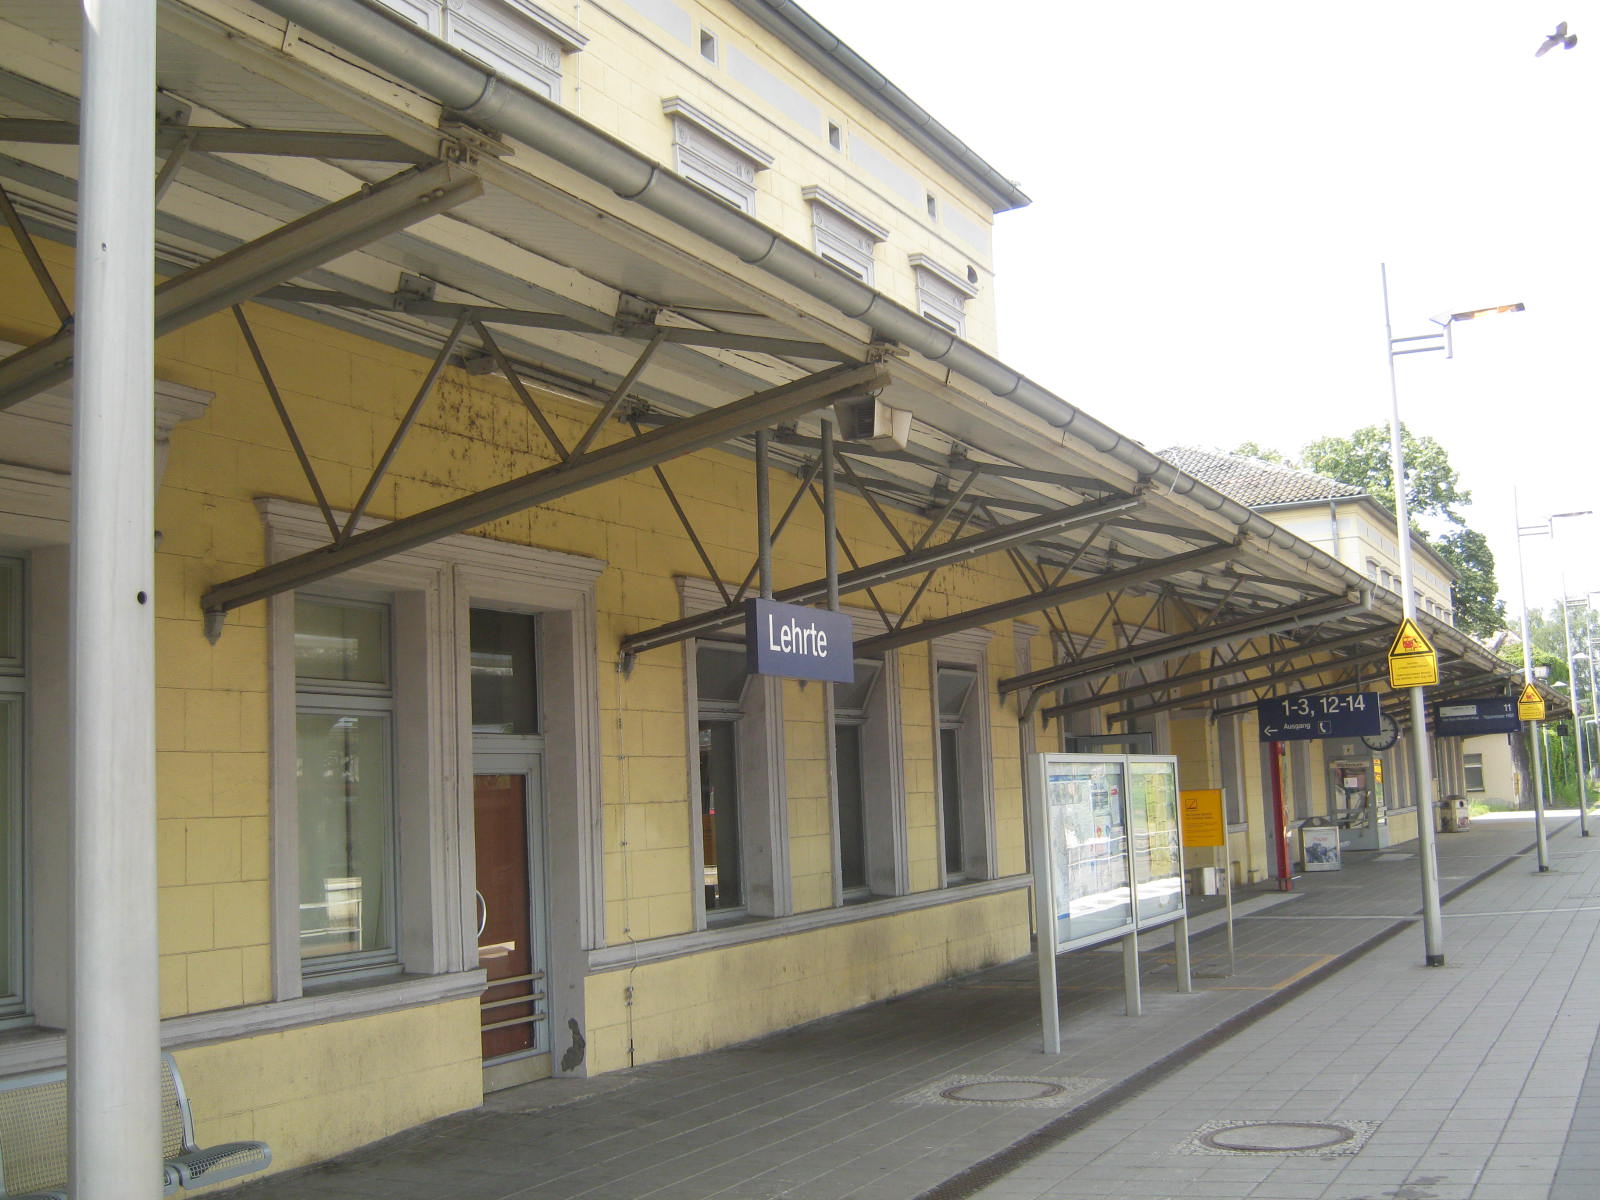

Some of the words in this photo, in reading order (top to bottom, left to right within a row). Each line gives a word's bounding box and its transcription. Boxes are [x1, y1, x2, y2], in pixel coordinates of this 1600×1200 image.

[768, 613, 828, 658] Lehrte
[1281, 698, 1315, 718] 1-3,
[1319, 694, 1366, 714] 12-14
[1503, 703, 1512, 712] 11
[1283, 722, 1311, 731] Ausgang
